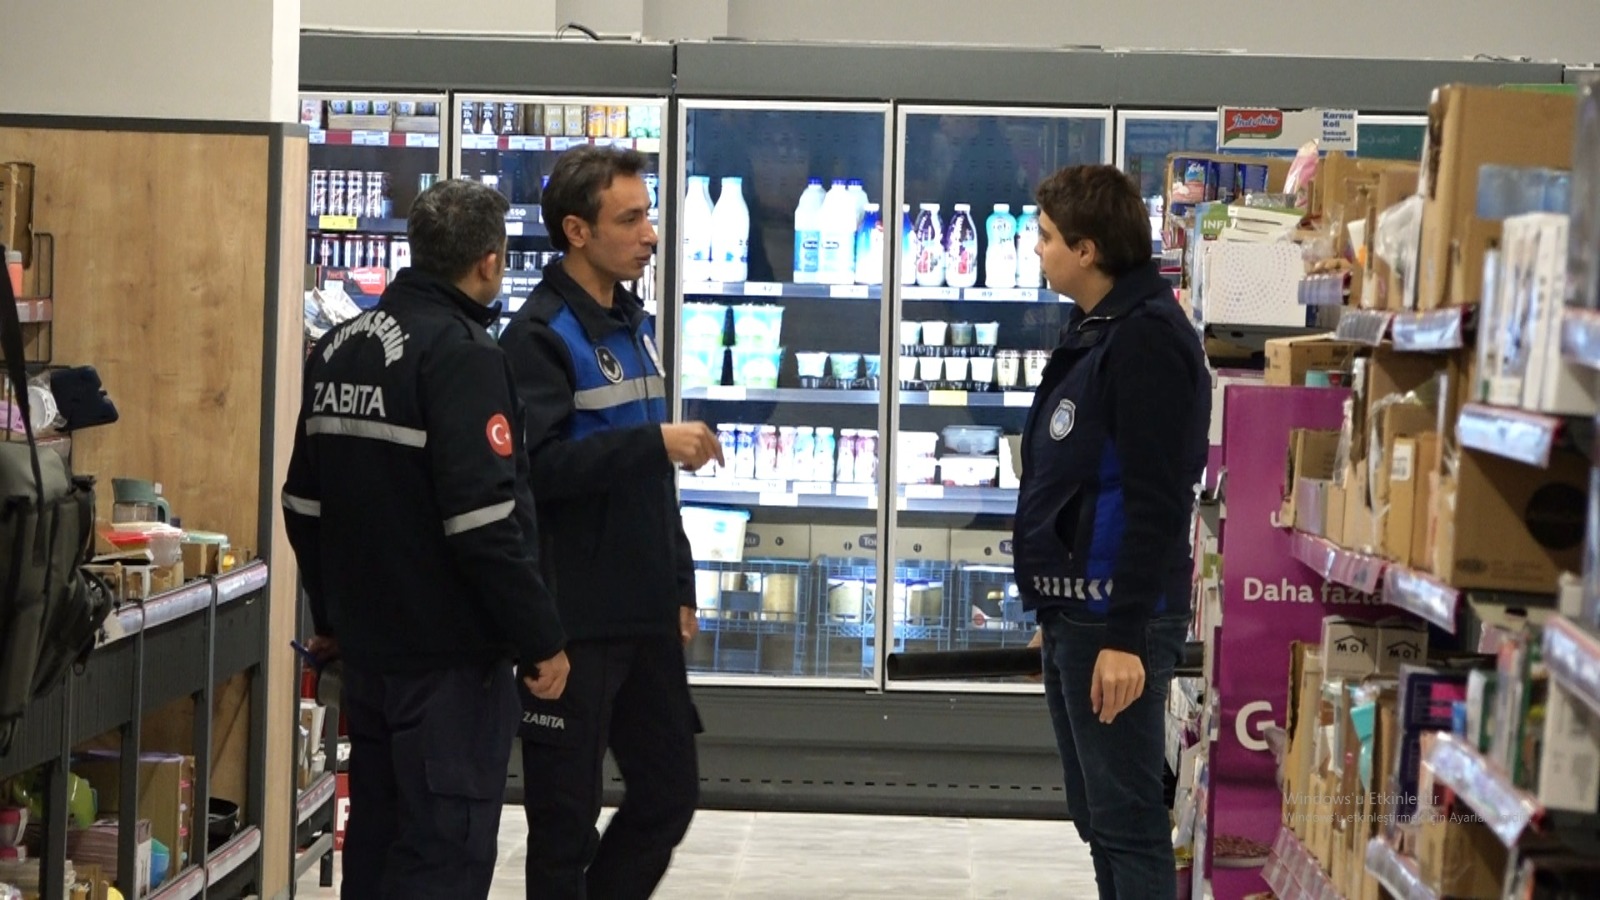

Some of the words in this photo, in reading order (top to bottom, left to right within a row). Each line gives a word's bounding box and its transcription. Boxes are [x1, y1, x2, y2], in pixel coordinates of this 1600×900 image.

[313, 382, 386, 417] ZABITA
[1244, 577, 1314, 602] Daha
[522, 711, 565, 729] ZABITA
